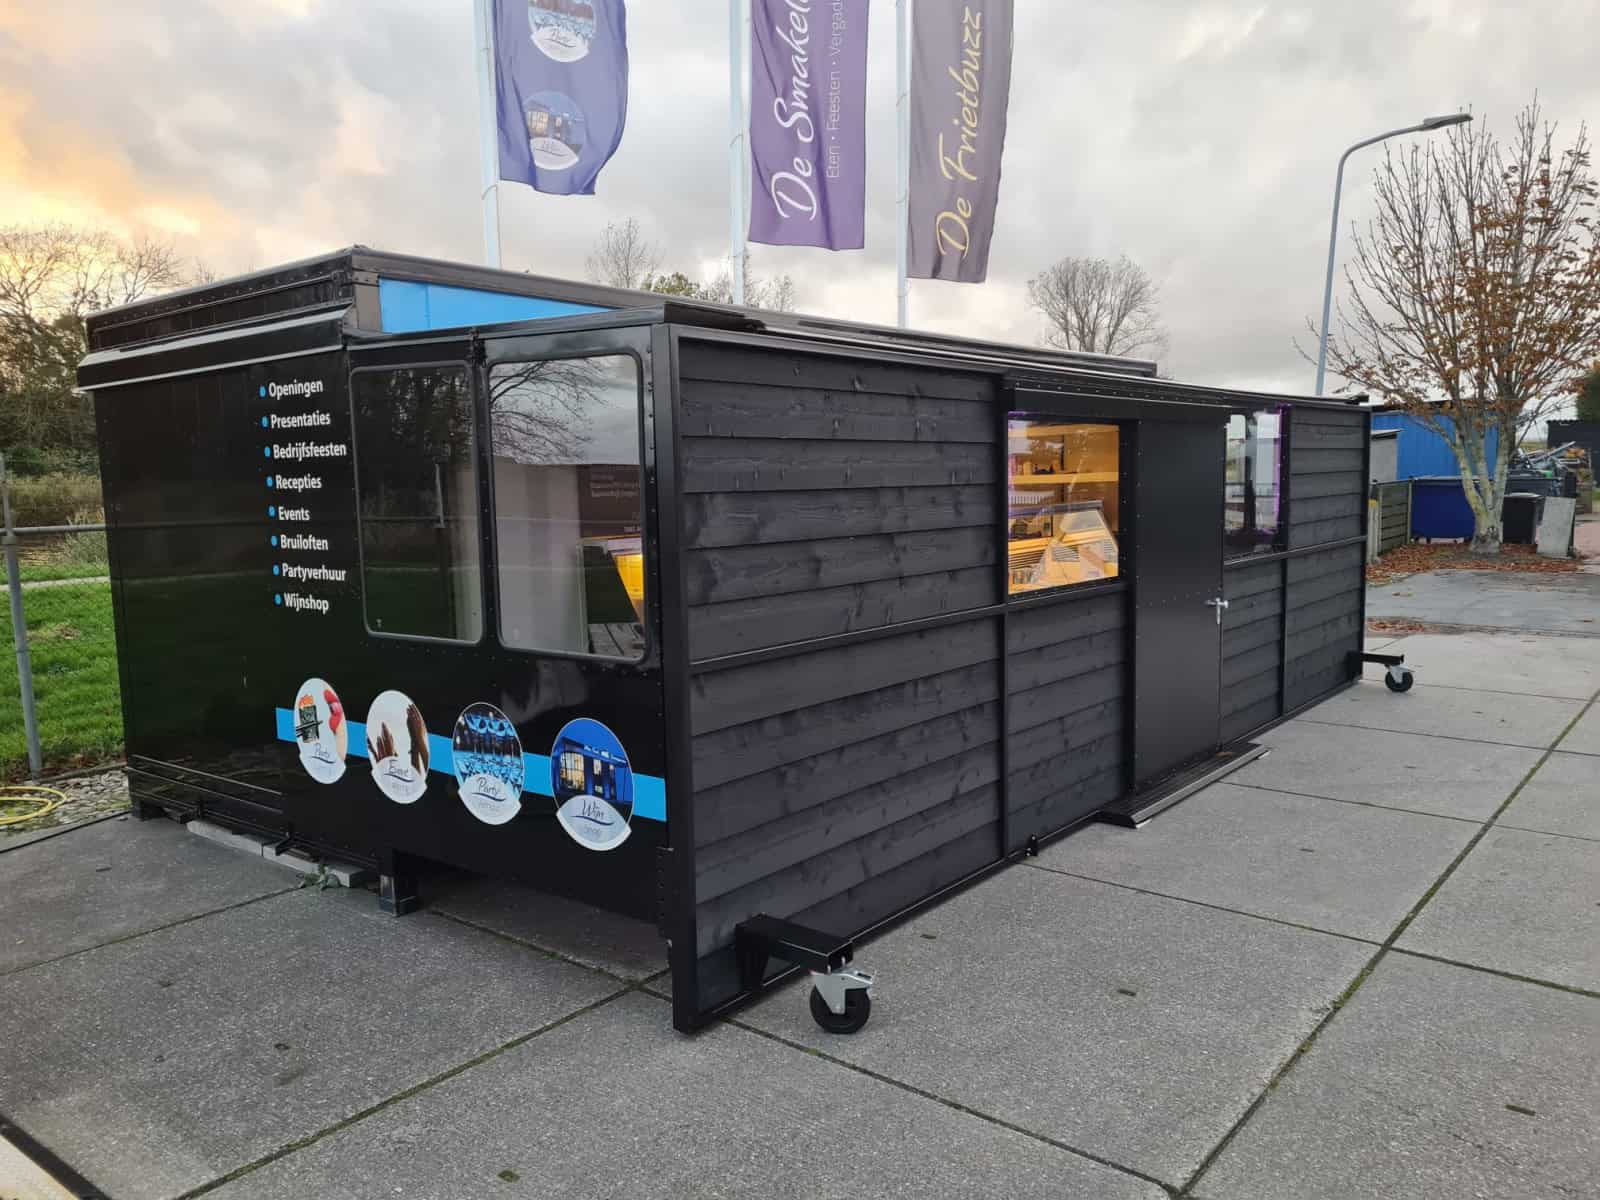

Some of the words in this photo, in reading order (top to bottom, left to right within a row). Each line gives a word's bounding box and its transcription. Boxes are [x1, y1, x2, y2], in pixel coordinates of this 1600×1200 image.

[828, 0, 848, 57] Vergad
[774, 0, 814, 143] Smakel
[826, 70, 841, 131] Feesten
[939, 6, 982, 182] Frietbuzz
[826, 145, 841, 179] Eten
[771, 157, 817, 221] De
[936, 197, 973, 259] De
[268, 378, 324, 401] Openingen
[271, 409, 331, 429] Presentaties
[273, 441, 347, 462] Bedrijfsfeesten
[275, 473, 322, 493] Recepties
[278, 506, 310, 521] Events
[280, 534, 329, 551] Bruiloften
[282, 563, 346, 582] Partyverhuur
[284, 592, 329, 614] Wijnshop
